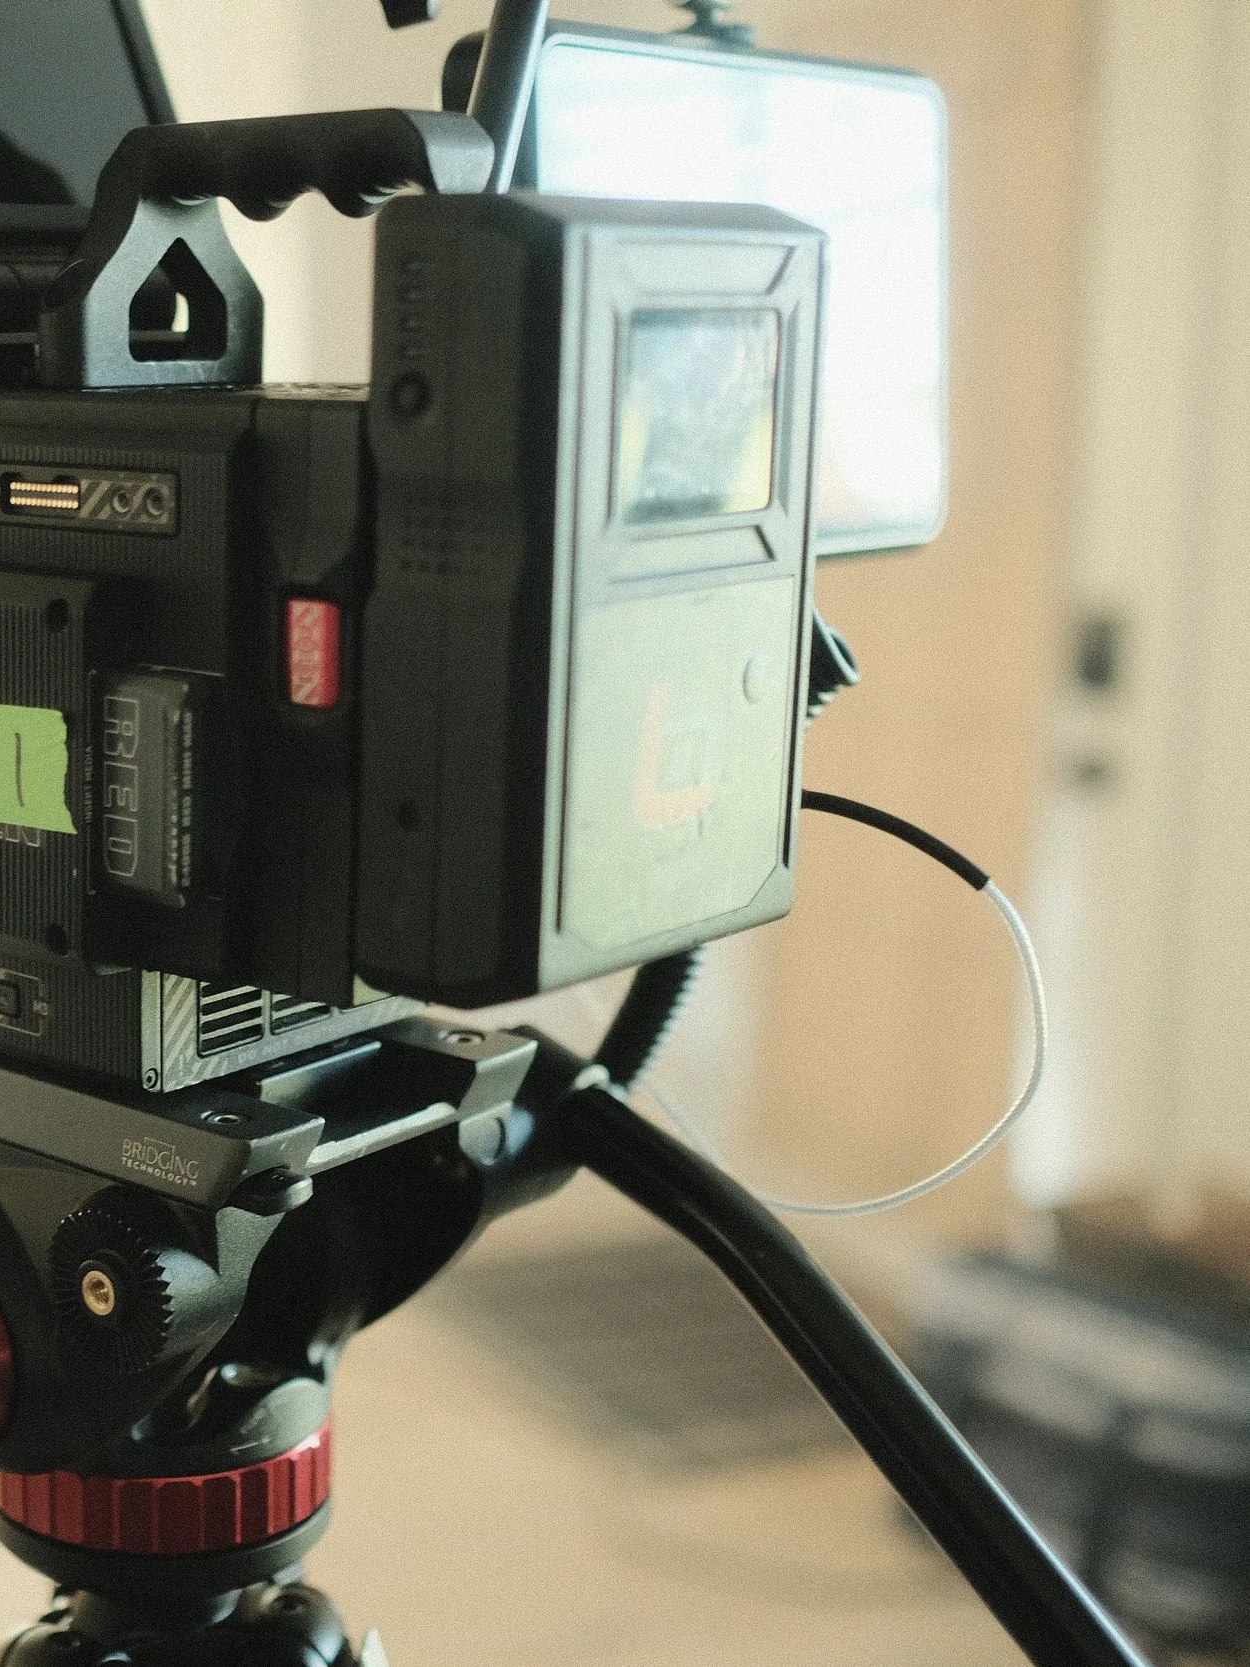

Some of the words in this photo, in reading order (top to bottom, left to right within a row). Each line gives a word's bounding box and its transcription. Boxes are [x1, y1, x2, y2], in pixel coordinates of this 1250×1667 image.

[84, 745, 93, 782] MEDIA
[84, 785, 93, 823] INSERT
[103, 695, 139, 877] RED
[121, 1137, 199, 1179] BRIDGING
